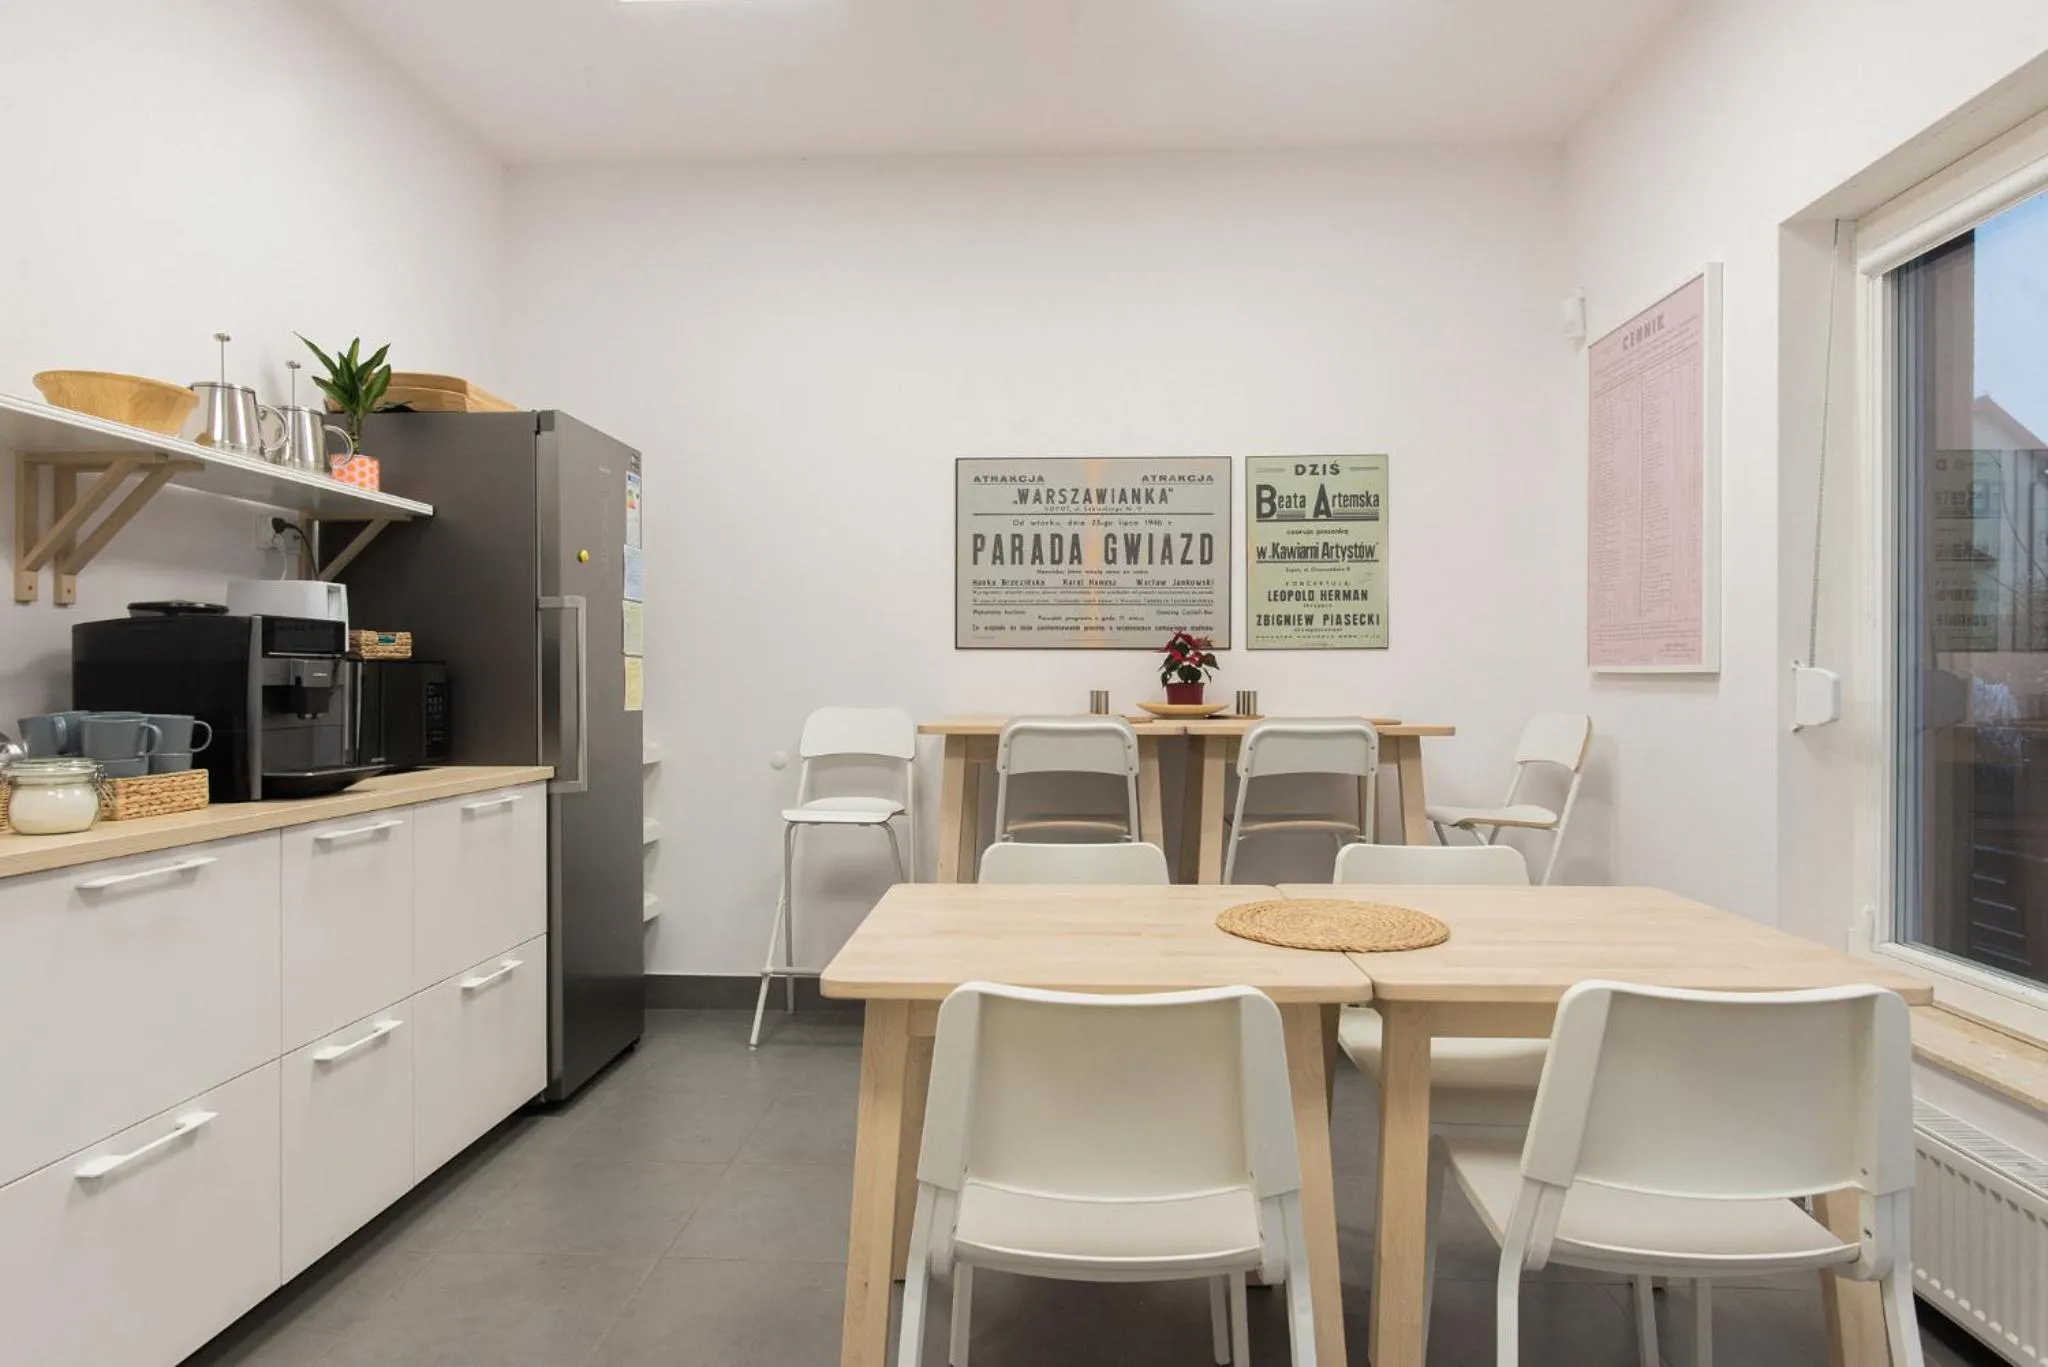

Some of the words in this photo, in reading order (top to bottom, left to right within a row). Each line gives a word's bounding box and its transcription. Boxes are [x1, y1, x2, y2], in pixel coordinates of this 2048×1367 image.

[1622, 312, 1666, 351] CENNIK
[1294, 460, 1341, 476] DZIŚ
[973, 475, 1045, 483] ATRAKCJA
[1142, 474, 1214, 482] ATRAKCJA
[1256, 484, 1306, 518] Beata
[1312, 483, 1379, 518] Artemska
[972, 533, 1083, 566] PARADA
[1104, 533, 1214, 566] GWIAZD
[1256, 545, 1268, 559] w
[1267, 589, 1315, 602] LEOPOLD
[1320, 589, 1368, 602] HERMAN
[1256, 614, 1314, 627] ZBIGNIEW
[1323, 613, 1380, 626] PIASECKI
